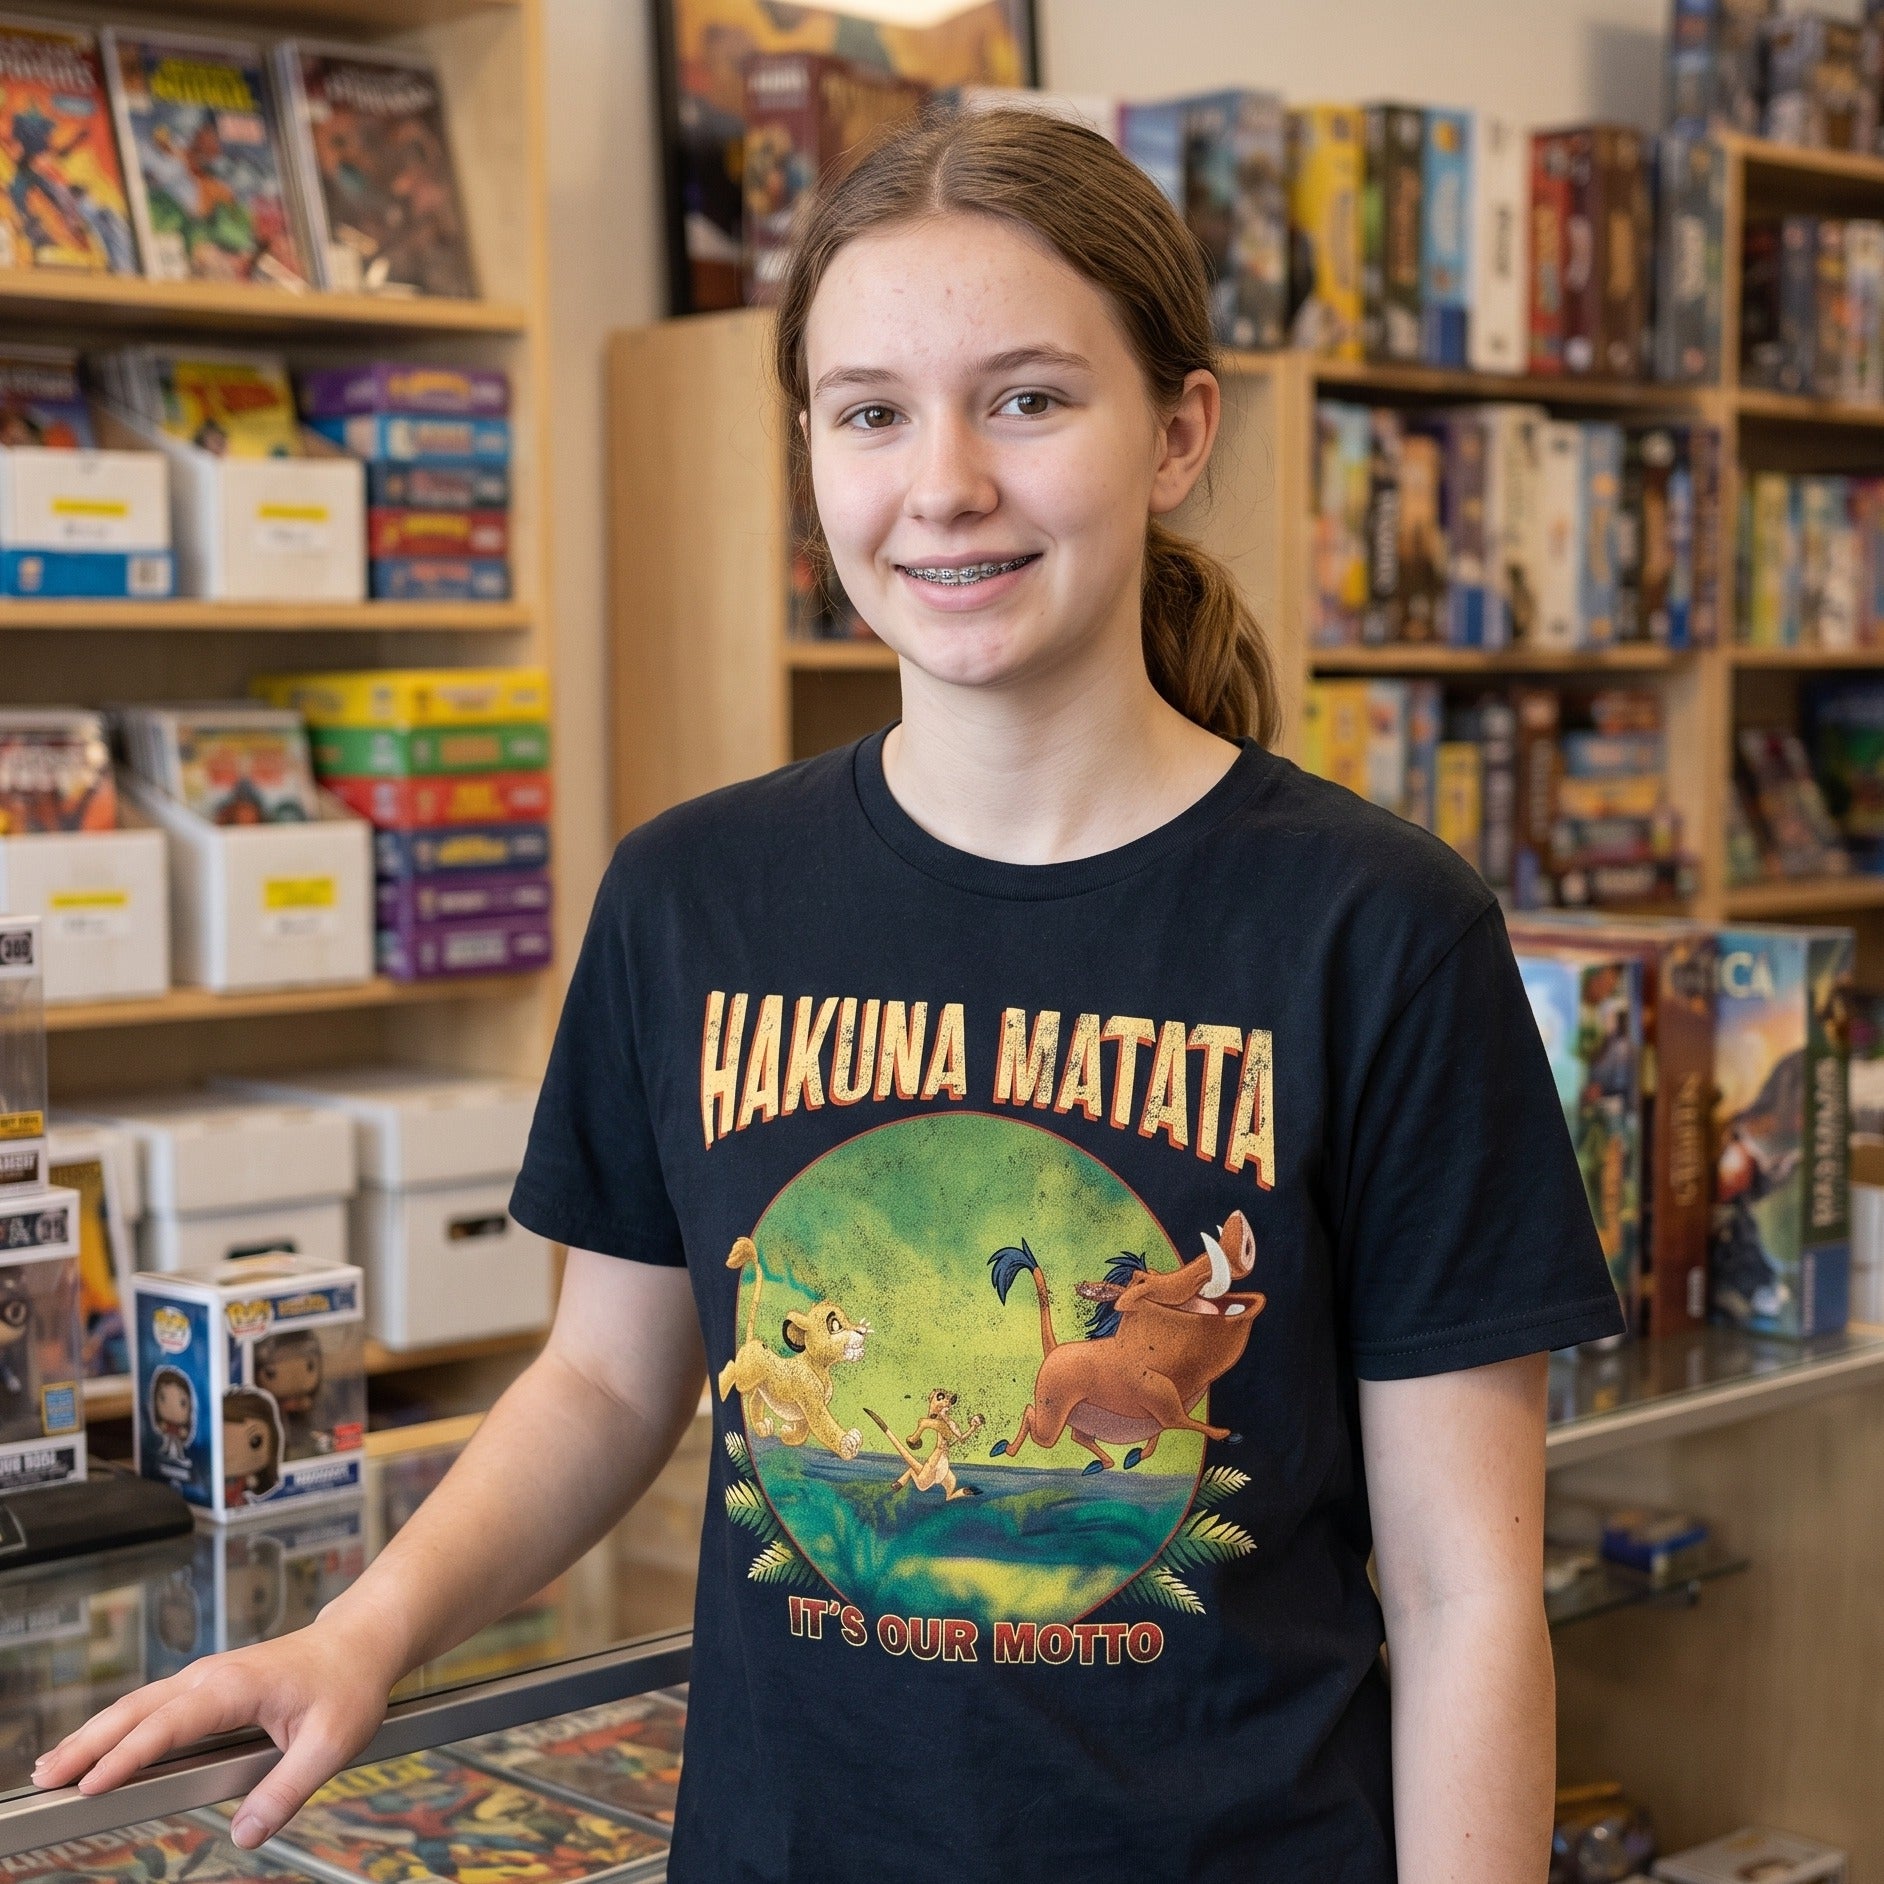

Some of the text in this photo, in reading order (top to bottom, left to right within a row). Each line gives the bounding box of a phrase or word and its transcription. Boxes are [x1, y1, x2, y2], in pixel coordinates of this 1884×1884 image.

[701, 990, 1275, 1191] HAKUNA MATATA
[788, 1596, 1164, 1665] IT'S OUR MOTTO
